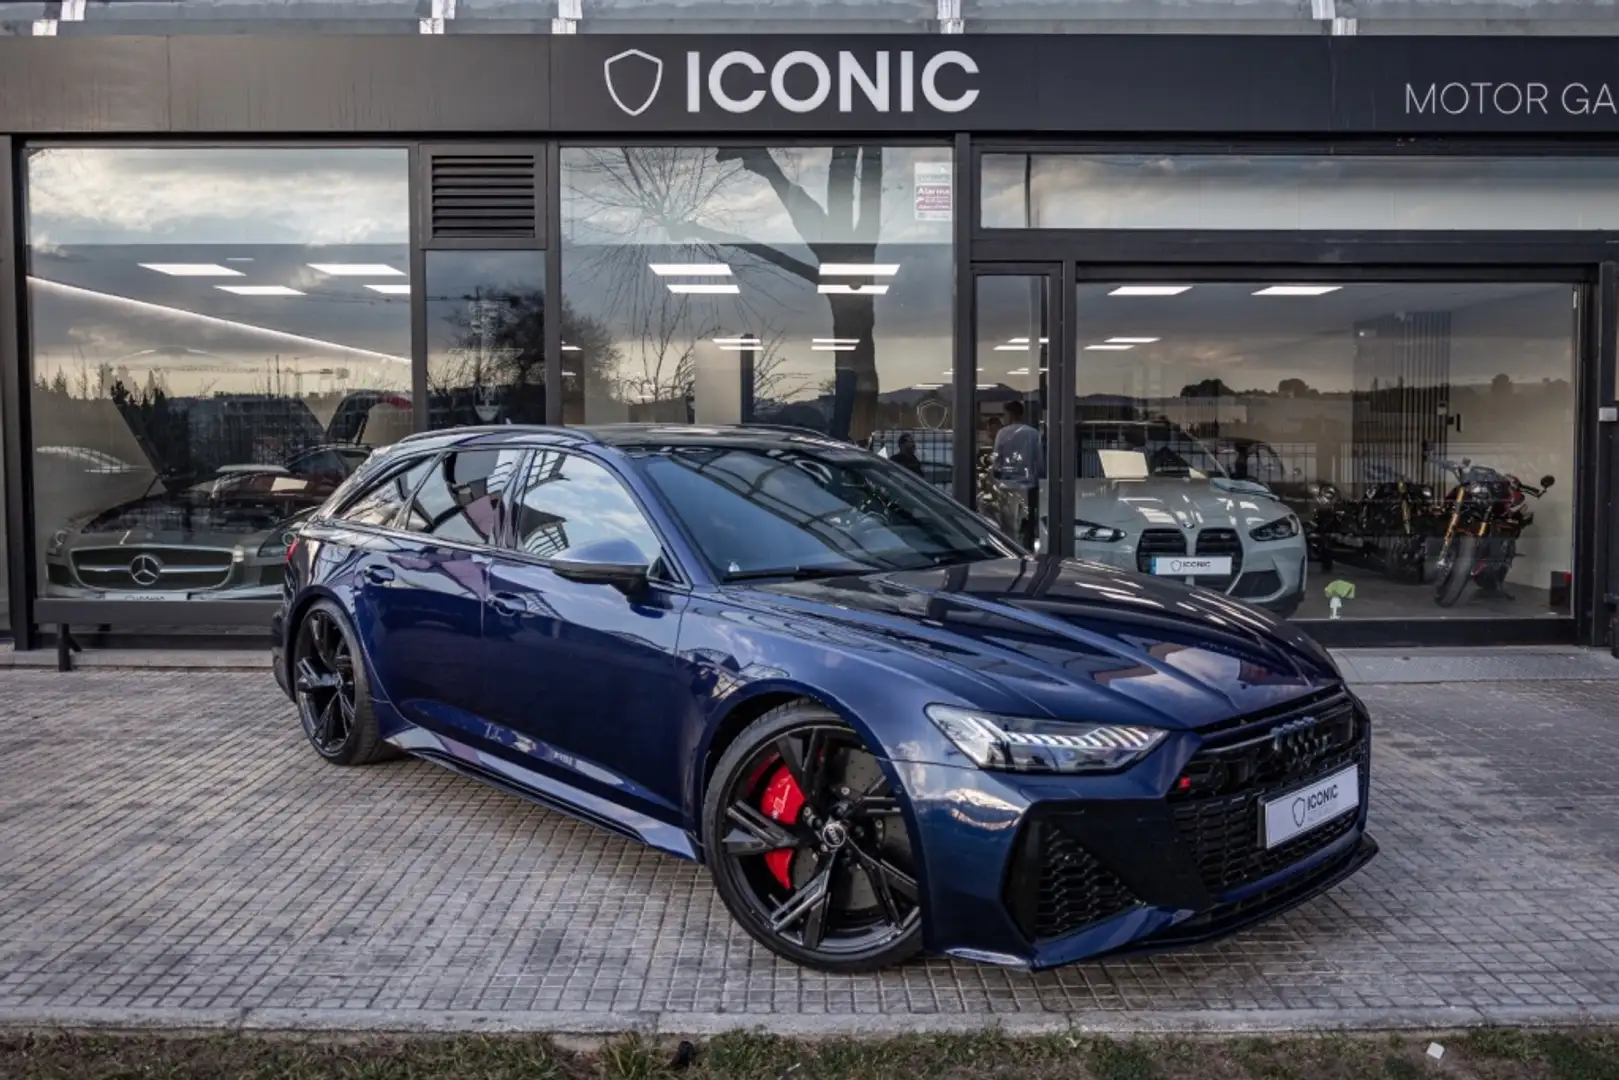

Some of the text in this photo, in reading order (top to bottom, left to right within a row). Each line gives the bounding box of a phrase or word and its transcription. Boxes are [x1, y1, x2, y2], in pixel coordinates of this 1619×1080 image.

[687, 50, 980, 113] ICONIC
[1405, 82, 1618, 114] MOTOR GA
[1307, 784, 1339, 811] ICONIC
